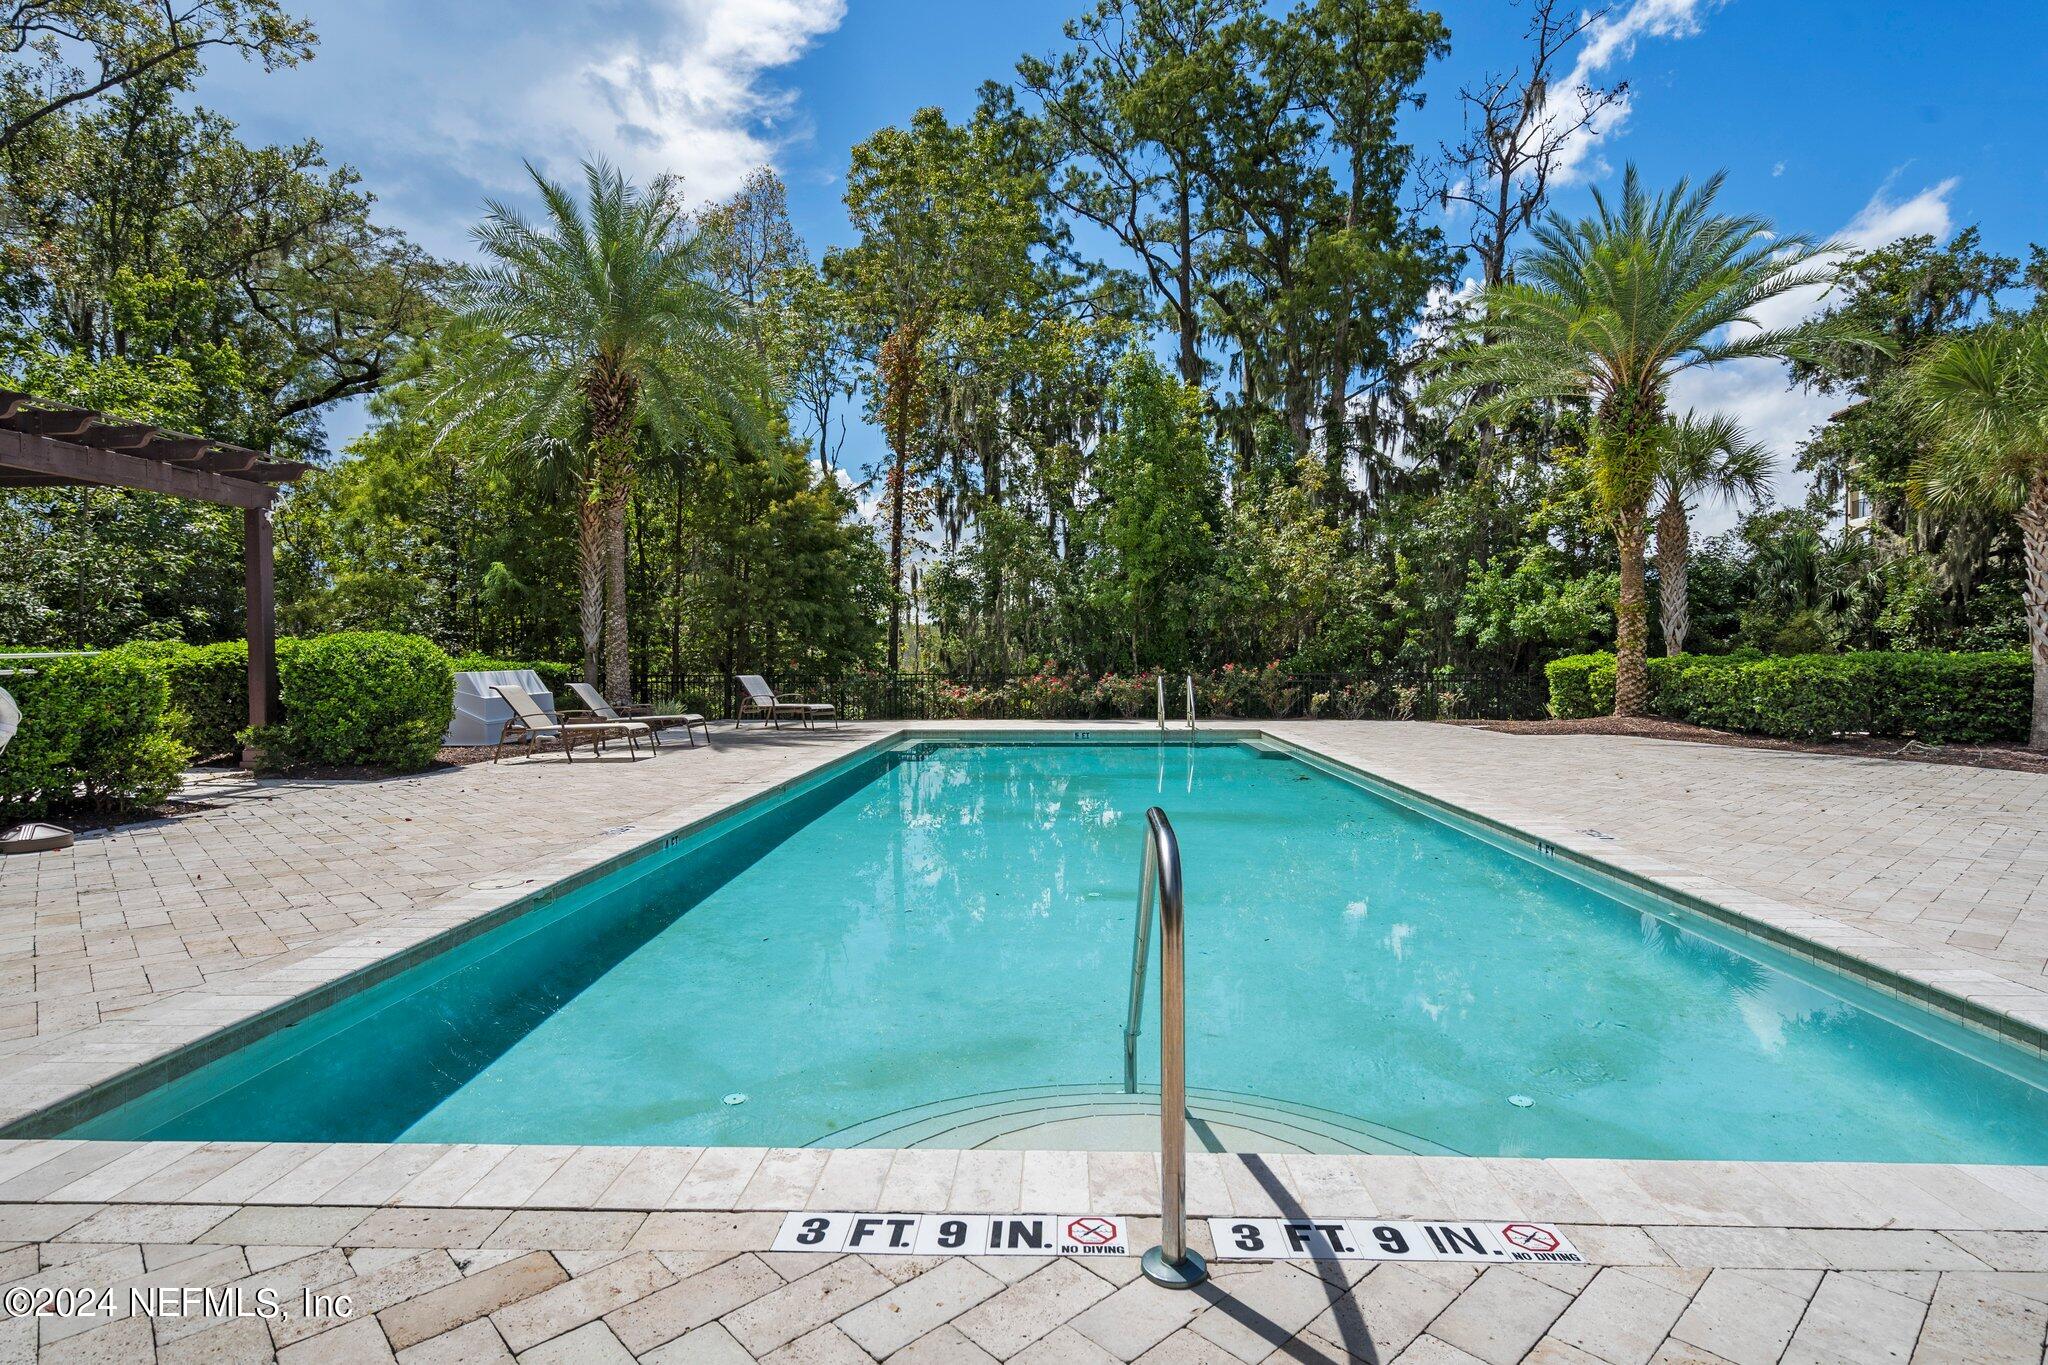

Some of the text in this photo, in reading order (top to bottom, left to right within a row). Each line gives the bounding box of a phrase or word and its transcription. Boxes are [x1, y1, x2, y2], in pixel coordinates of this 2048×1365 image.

[796, 1217, 1053, 1249] 3 FT. 9 IN.
[1231, 1223, 1503, 1256] 3 FT. 9 IN.
[1061, 1245, 1125, 1254] NO DIVING
[1511, 1252, 1581, 1261] NO DIVING
